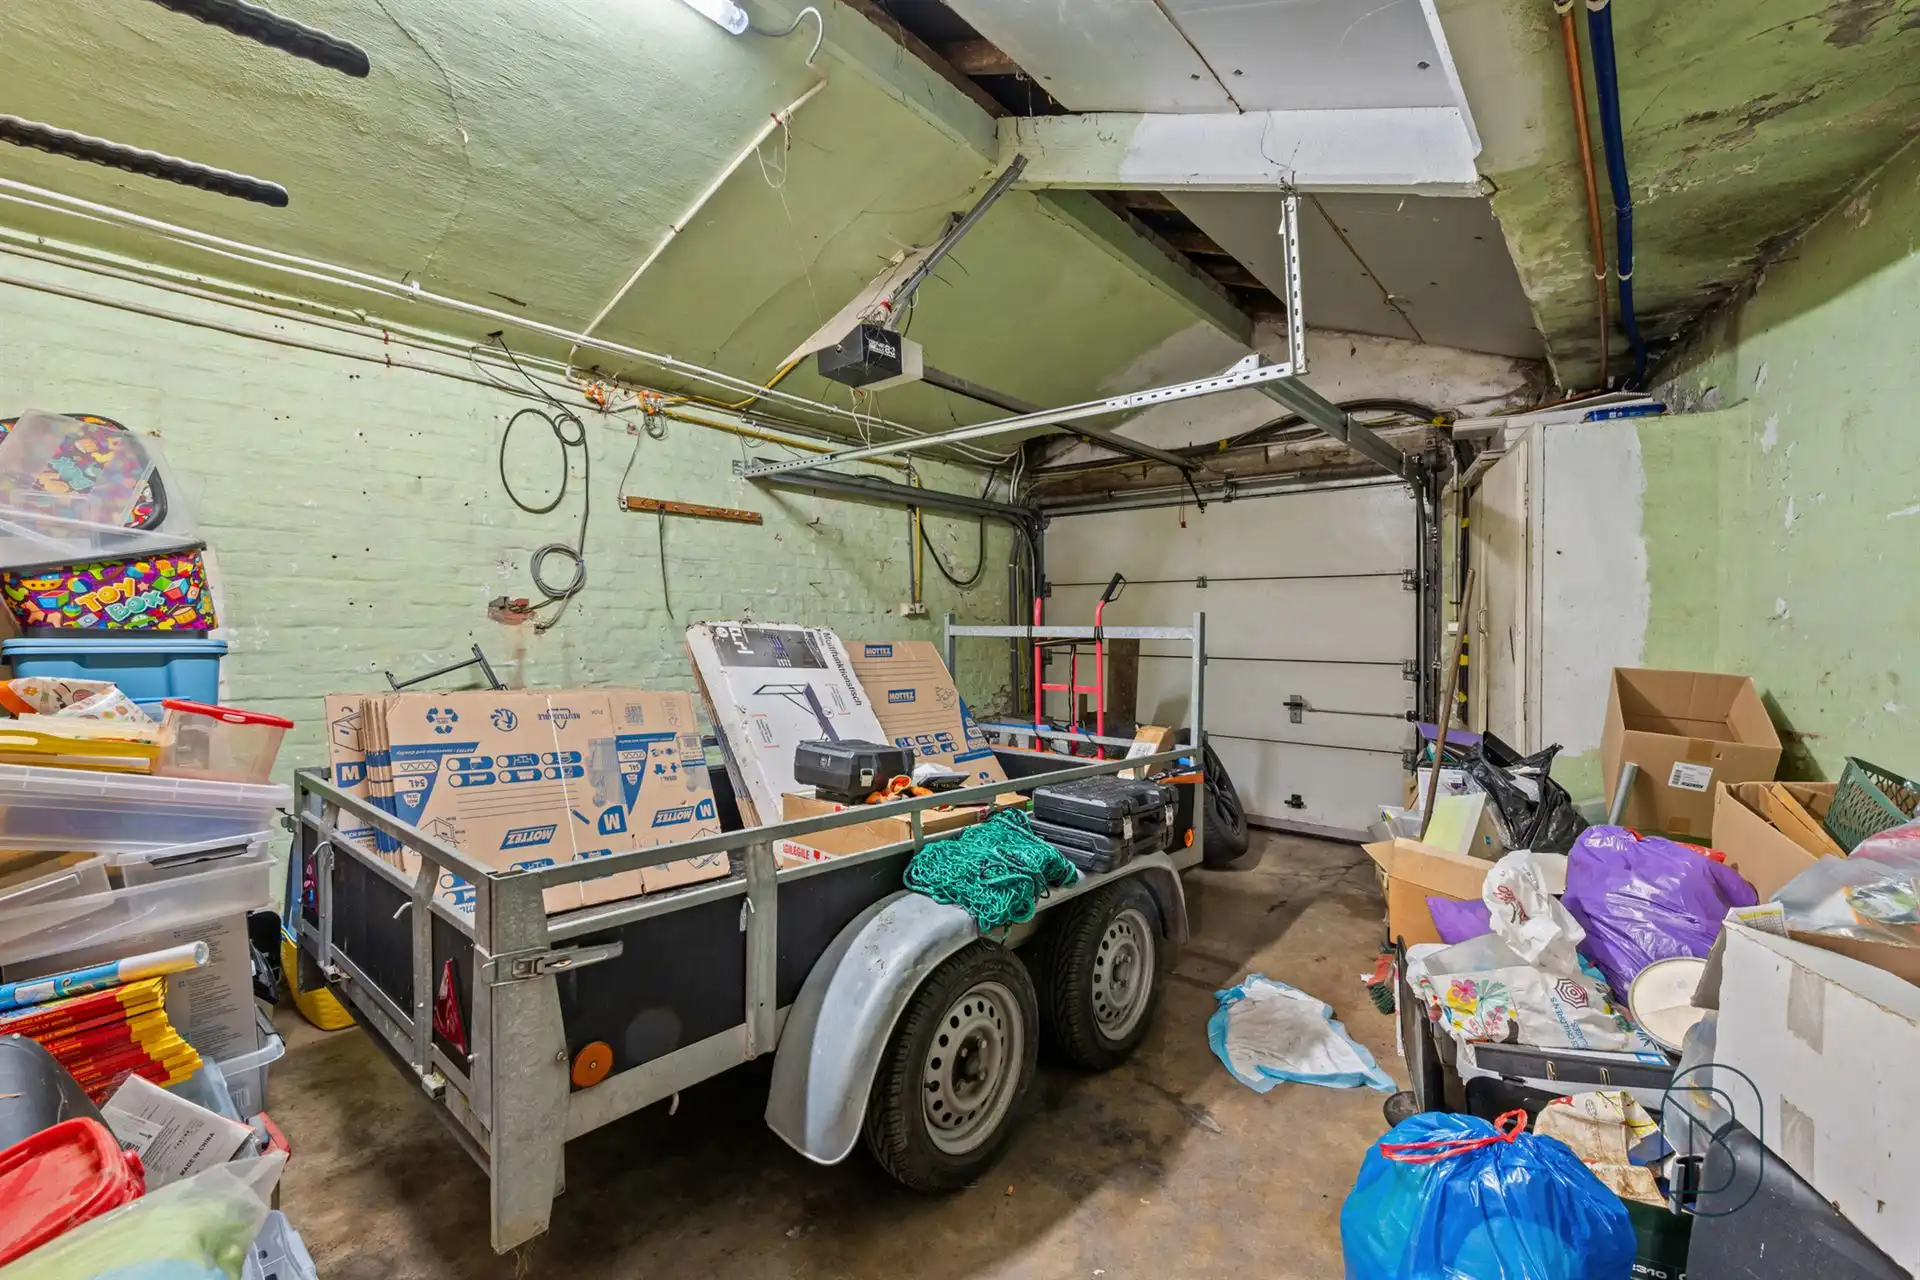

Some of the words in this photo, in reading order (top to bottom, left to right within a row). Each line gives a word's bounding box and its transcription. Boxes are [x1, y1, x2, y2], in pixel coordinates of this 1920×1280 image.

[75, 578, 136, 611] TOY
[105, 591, 166, 622] BOX
[822, 632, 863, 707] Multifunktionstisch
[342, 766, 360, 781] M
[656, 810, 691, 824] MOTTEZ
[700, 804, 712, 817] M
[603, 814, 621, 830] M
[505, 829, 552, 844] MOTTEZ
[179, 1158, 196, 1177] MADE
[198, 1133, 216, 1152] CHINA
